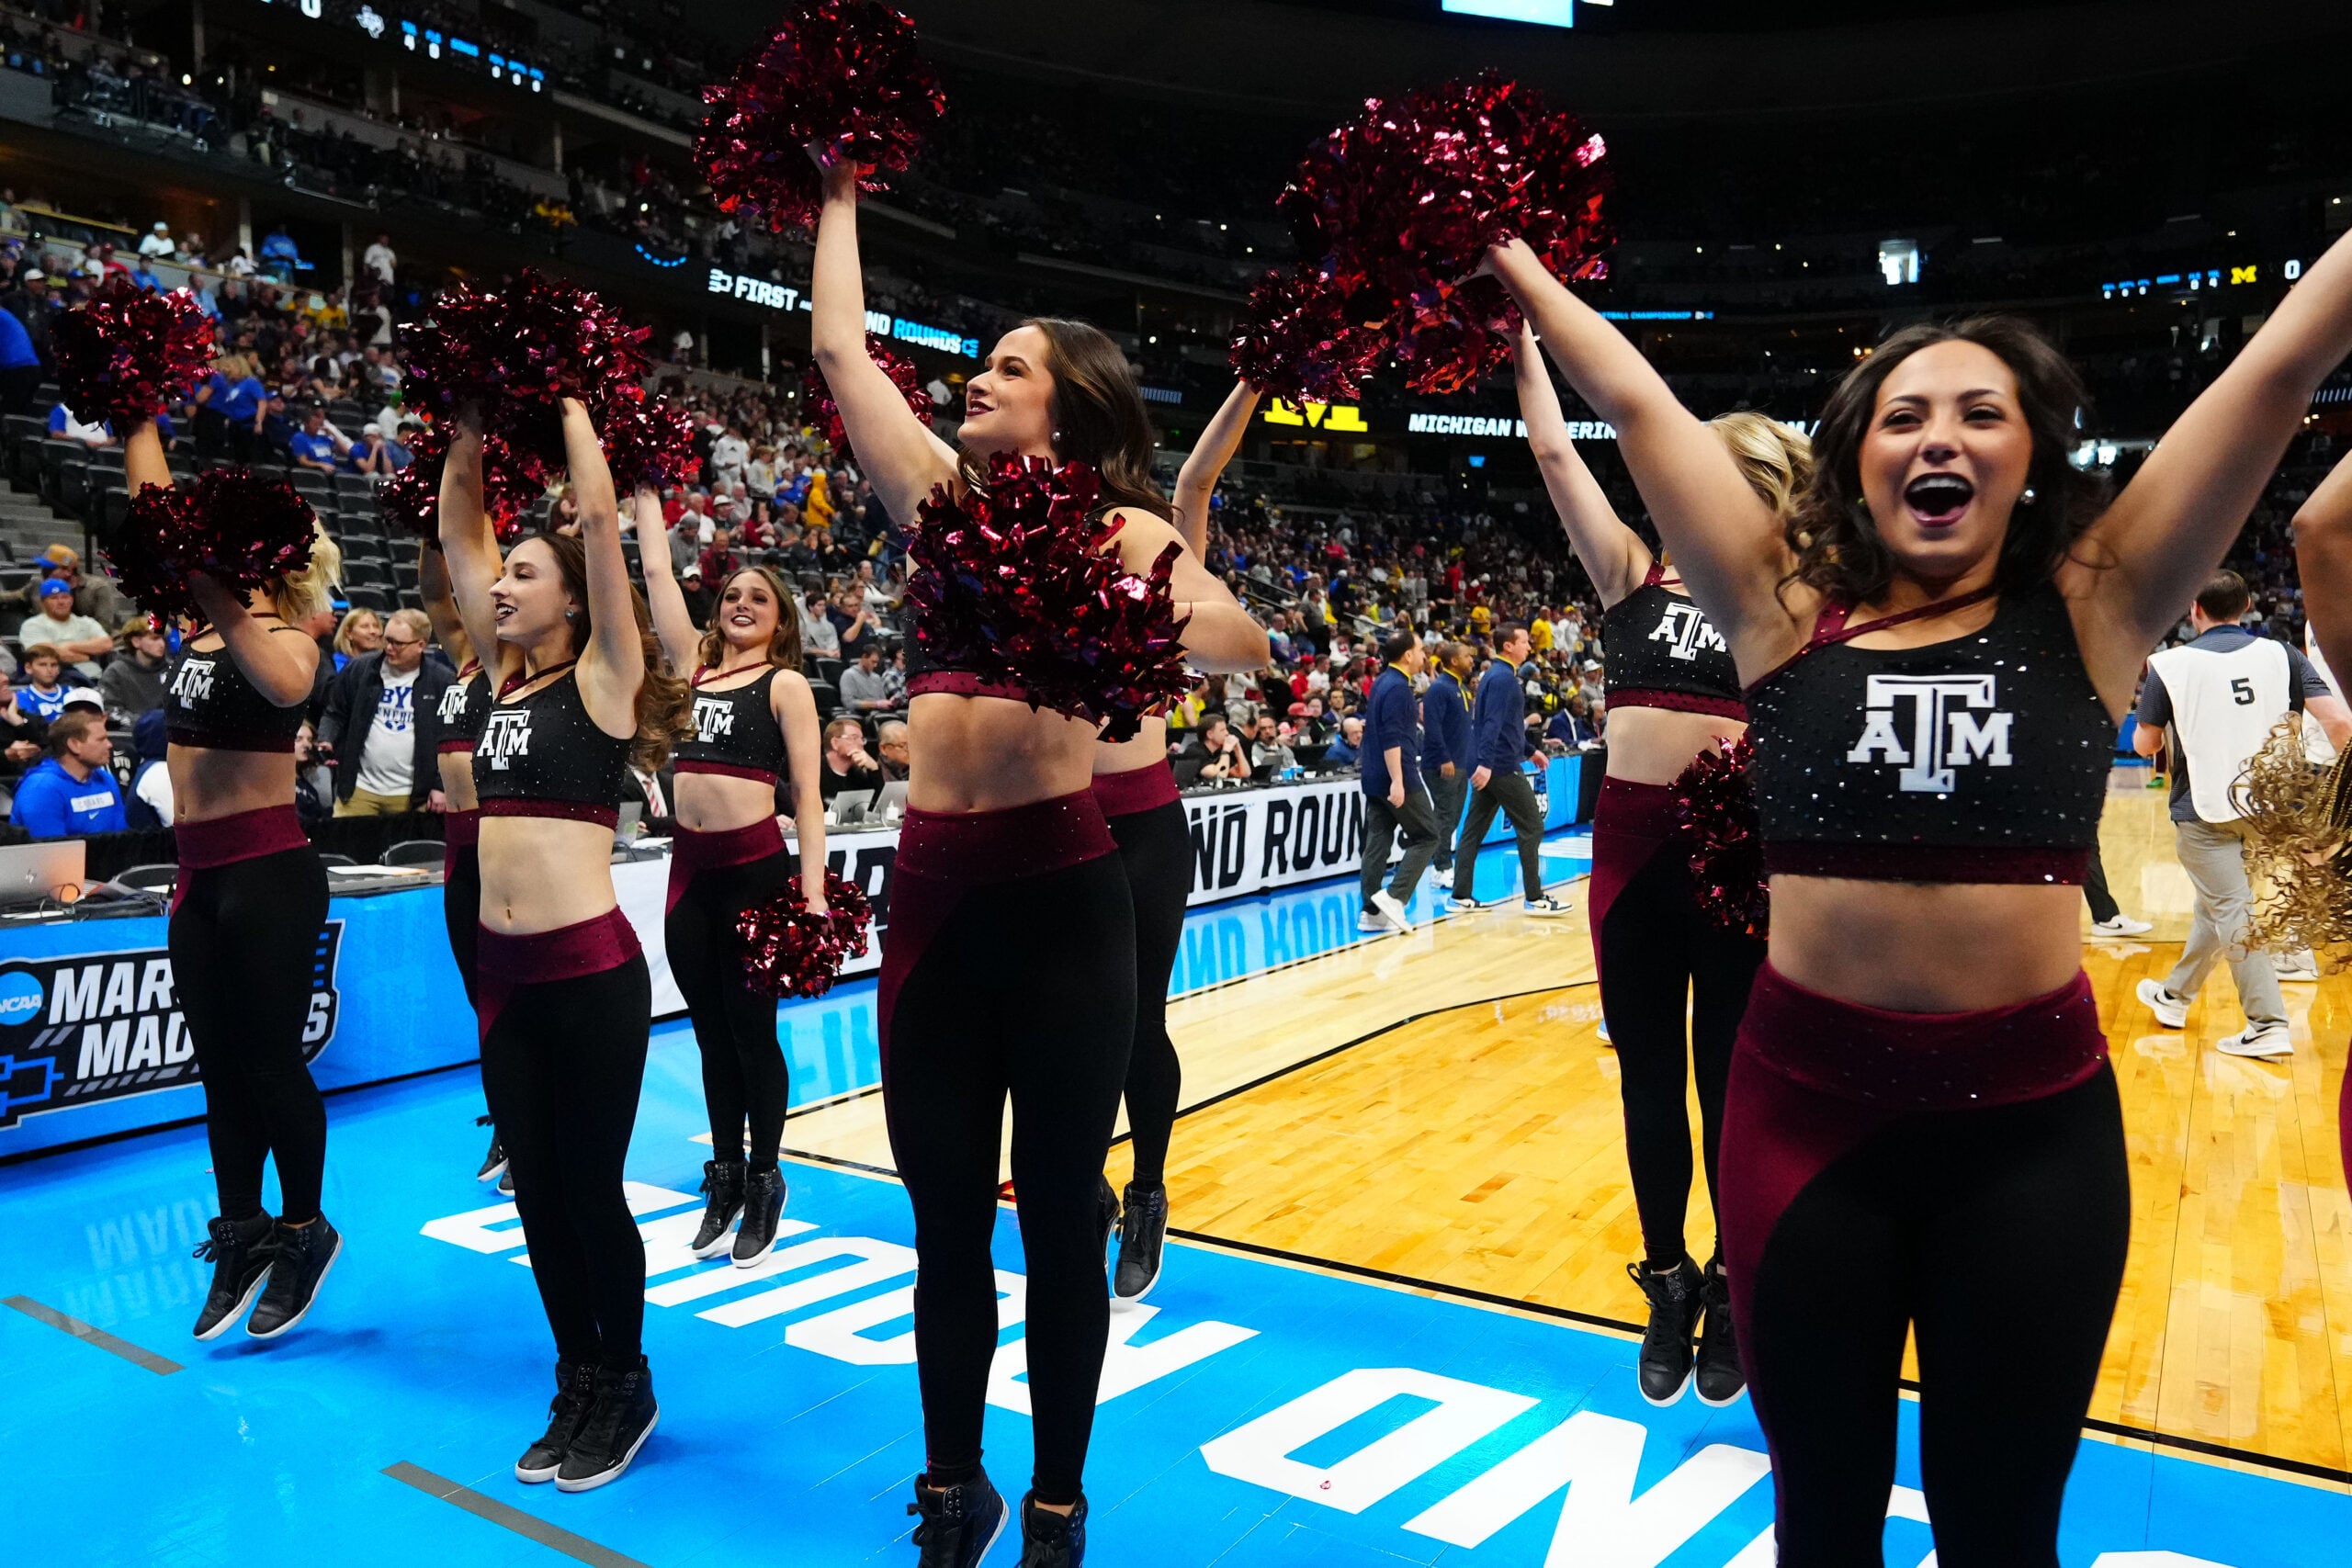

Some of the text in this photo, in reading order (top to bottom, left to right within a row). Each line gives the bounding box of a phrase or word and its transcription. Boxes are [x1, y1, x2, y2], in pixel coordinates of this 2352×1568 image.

[2285, 259, 2301, 280] 0
[735, 276, 798, 311] FIRST
[892, 318, 962, 355] ROUNDS
[1408, 413, 1511, 437] MICHIGAN
[379, 686, 414, 708] BY
[2231, 677, 2255, 705] 5
[49, 958, 180, 1025] MAR
